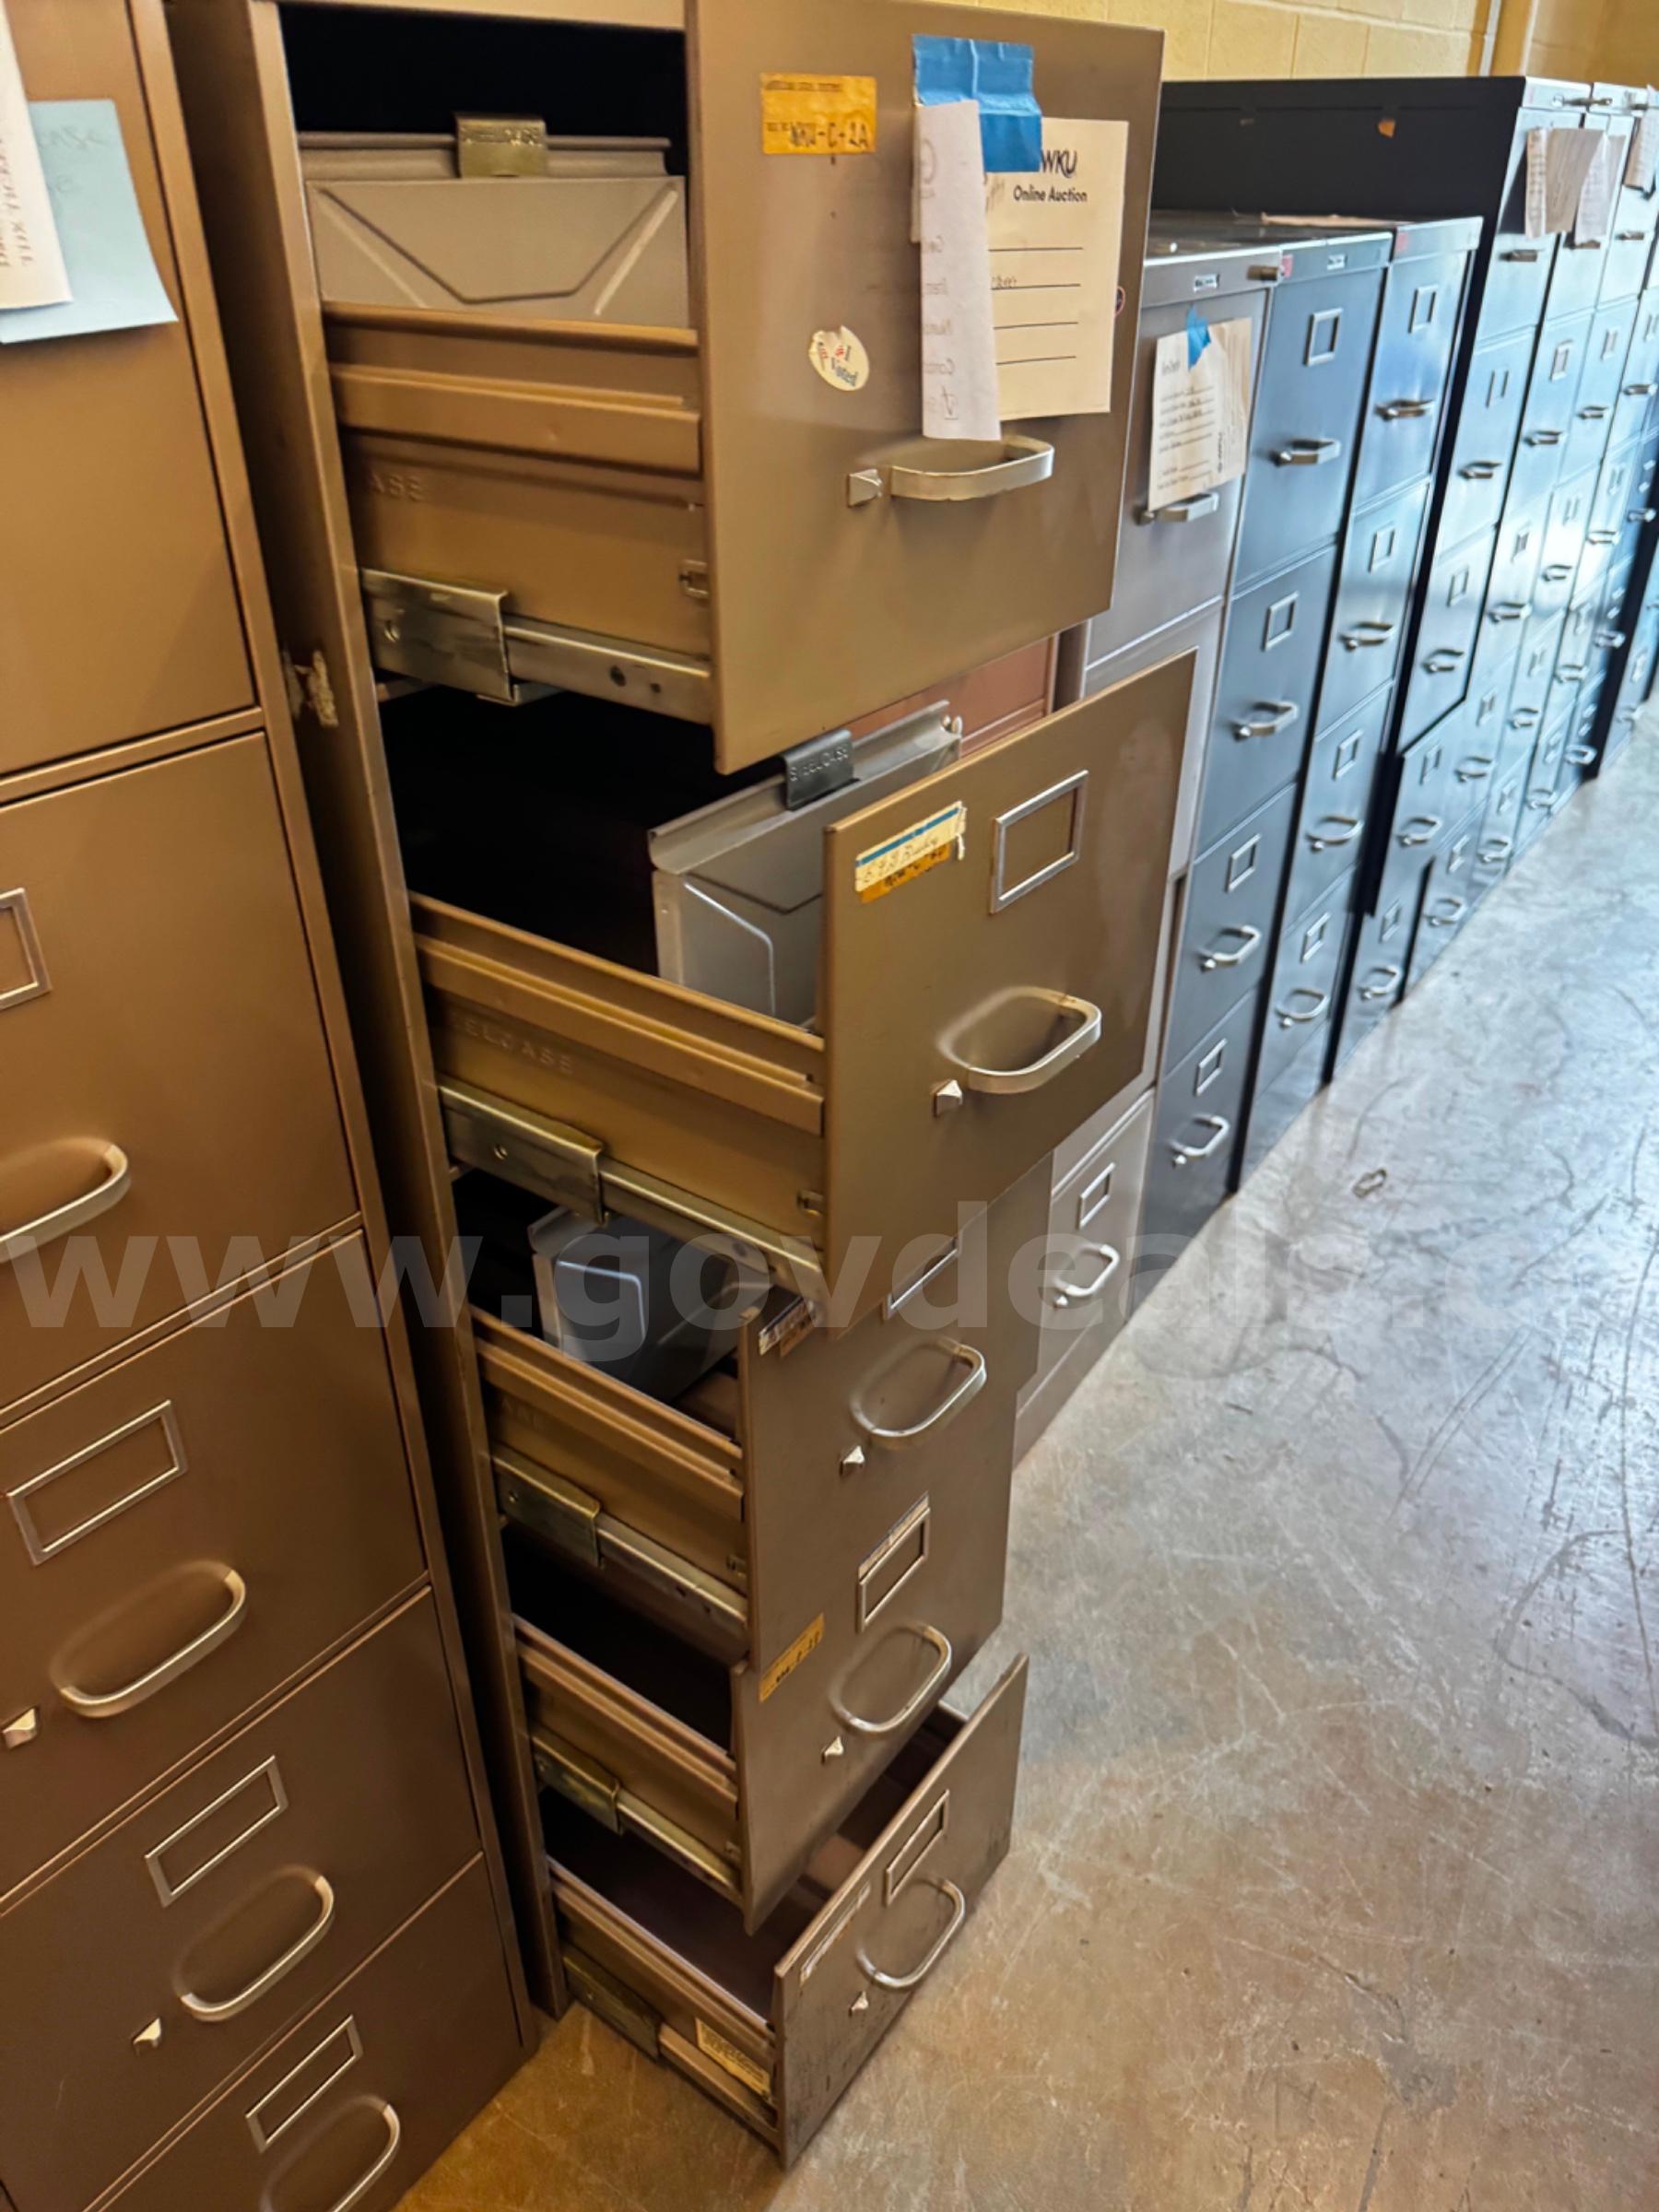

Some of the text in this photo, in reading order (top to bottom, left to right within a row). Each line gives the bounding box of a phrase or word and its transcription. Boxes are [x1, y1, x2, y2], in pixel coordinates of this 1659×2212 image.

[1041, 149, 1077, 178] WKU
[1014, 183, 1046, 201] Online
[1048, 186, 1088, 203] Auction
